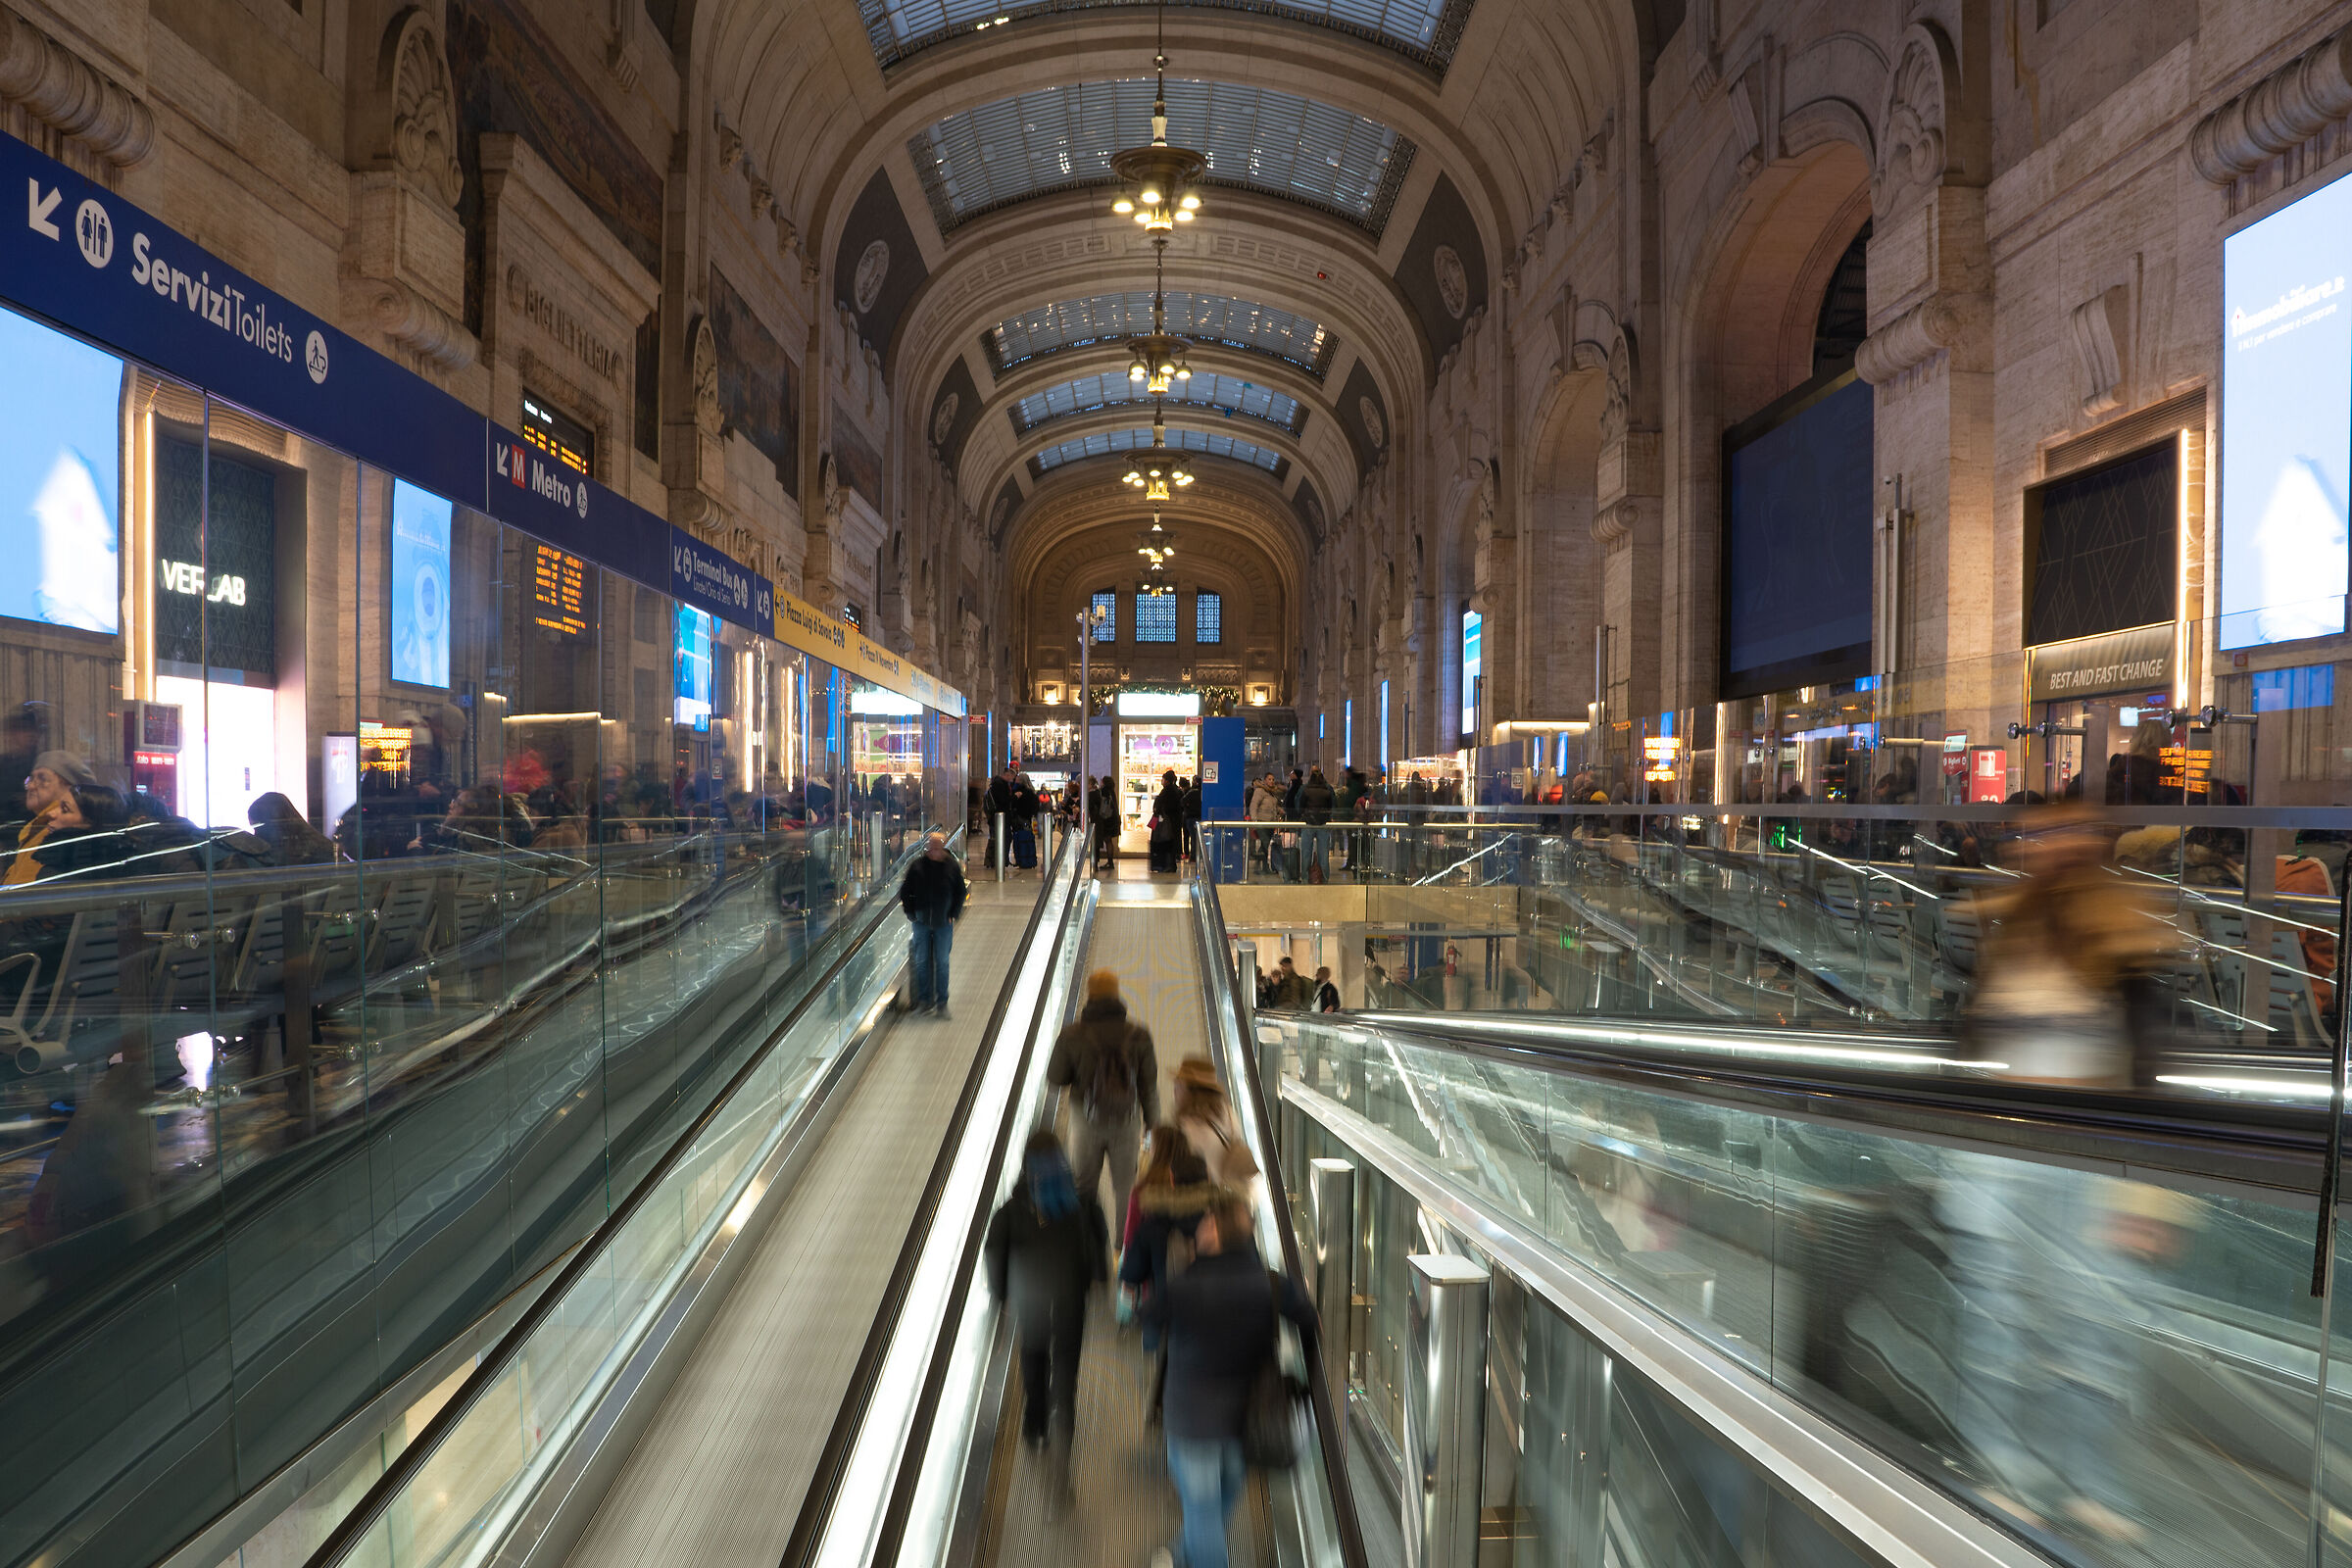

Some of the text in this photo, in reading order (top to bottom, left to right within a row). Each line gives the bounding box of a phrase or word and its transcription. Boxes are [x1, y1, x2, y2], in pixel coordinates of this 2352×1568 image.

[131, 231, 293, 364] Servizi Toilets
[532, 459, 571, 508] Metro
[693, 551, 733, 590] Terminal Bus
[787, 600, 802, 625] Piazza
[803, 609, 813, 635] Luigi
[813, 614, 818, 633] di
[818, 617, 832, 641] Savoia
[2049, 659, 2164, 690] BEST AND FAST CHANGE
